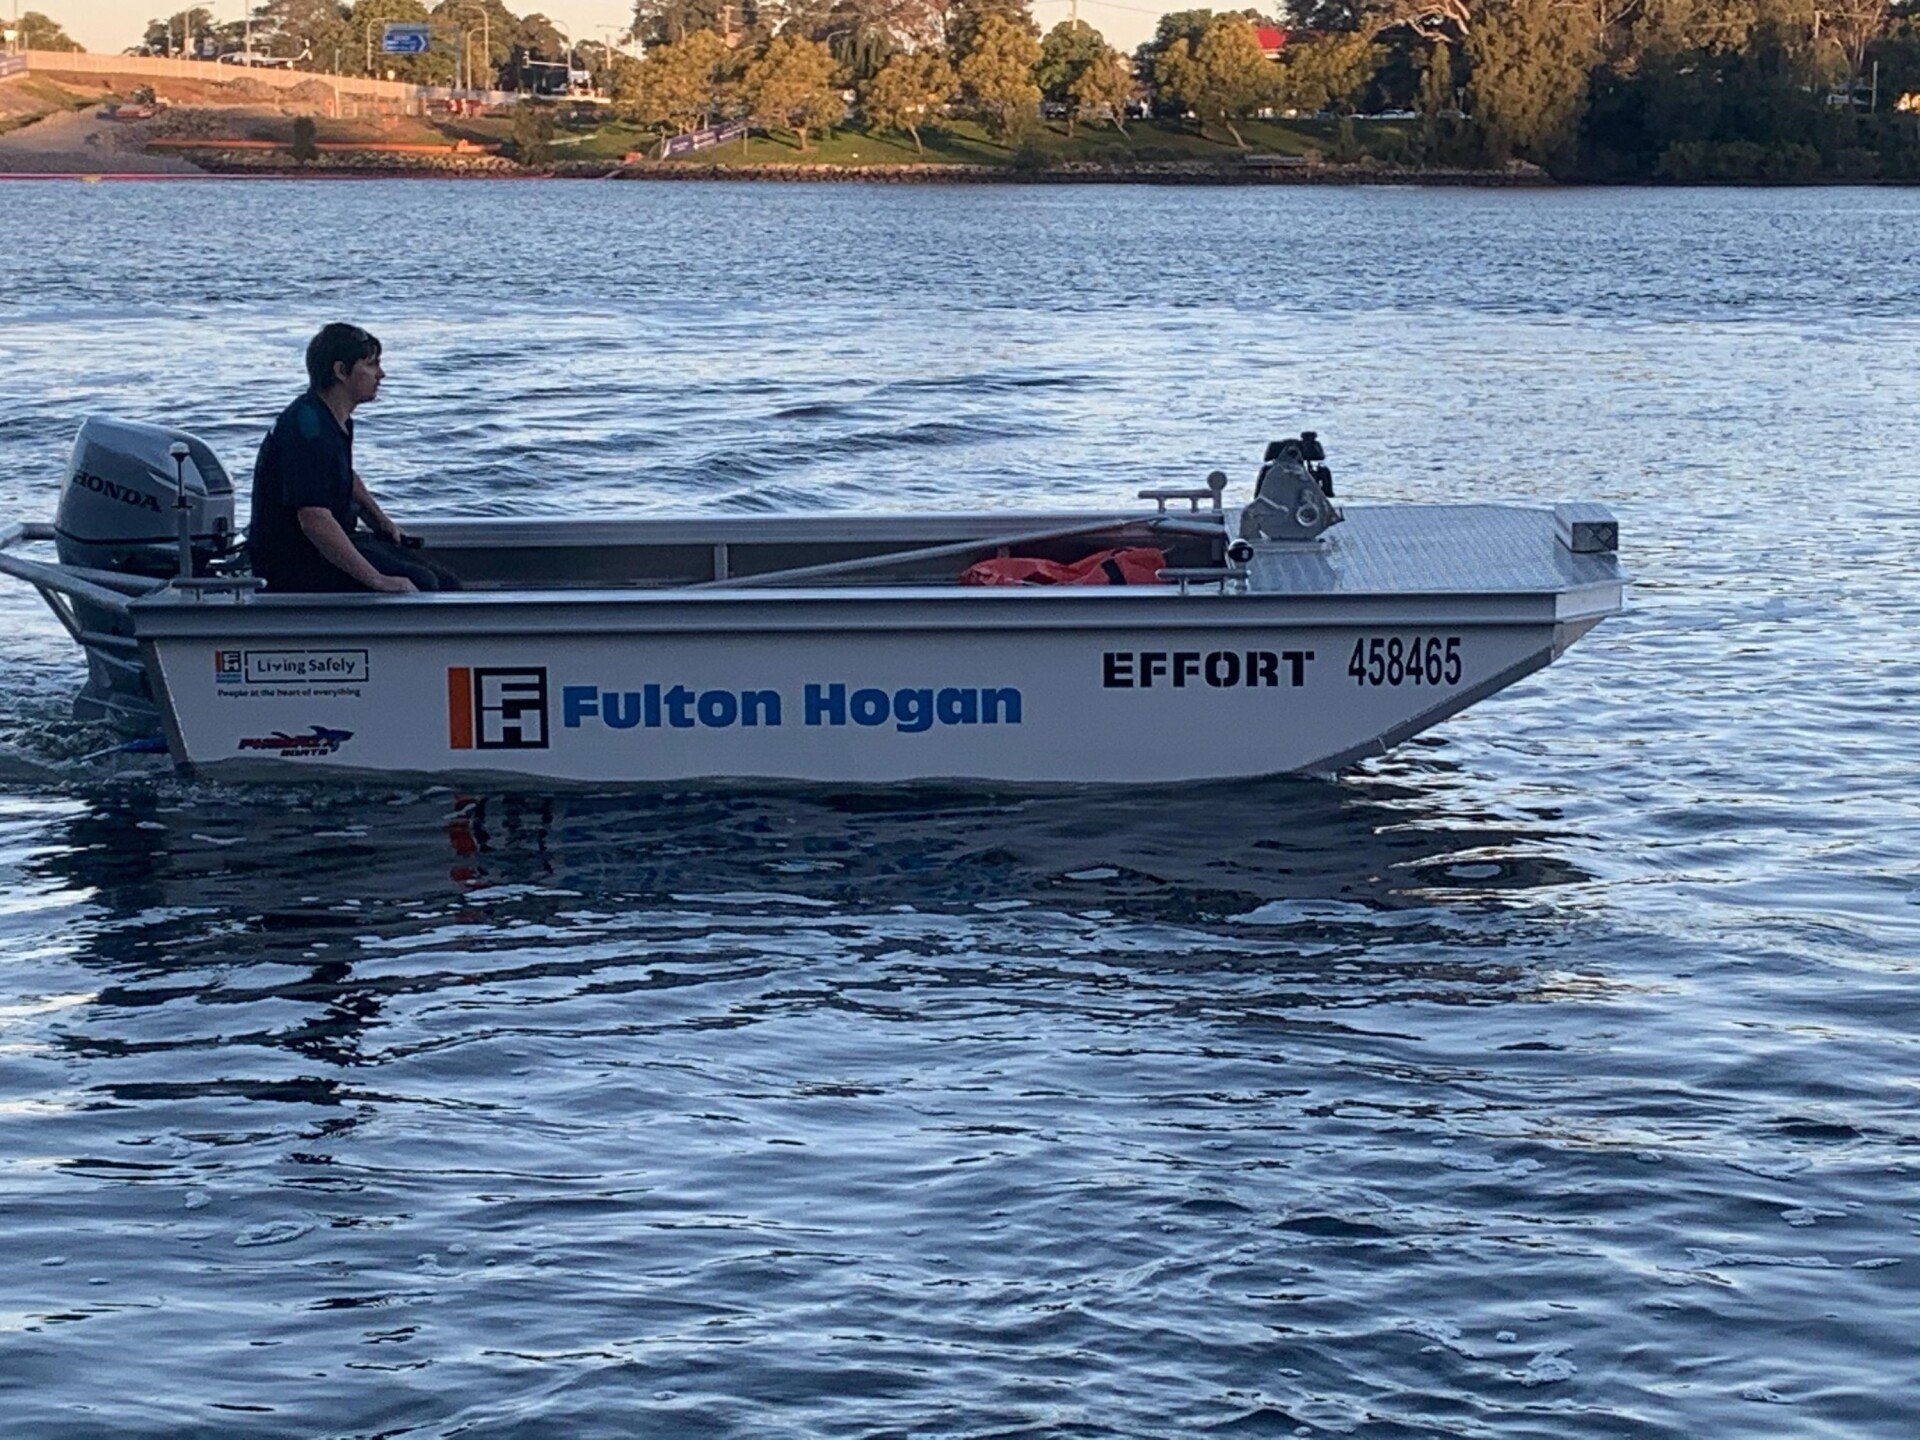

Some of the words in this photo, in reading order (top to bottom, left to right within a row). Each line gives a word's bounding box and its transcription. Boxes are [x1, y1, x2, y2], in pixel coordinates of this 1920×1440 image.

[73, 469, 163, 514] HONDA
[257, 658, 306, 675] Living
[309, 657, 356, 674] Safely
[1103, 651, 1315, 688] EFFORT
[1348, 636, 1462, 686] 458465
[217, 688, 249, 698] People
[276, 688, 300, 696] heart
[313, 687, 361, 698] everything
[562, 683, 782, 729] Fulton
[803, 683, 1022, 733] Hogan
